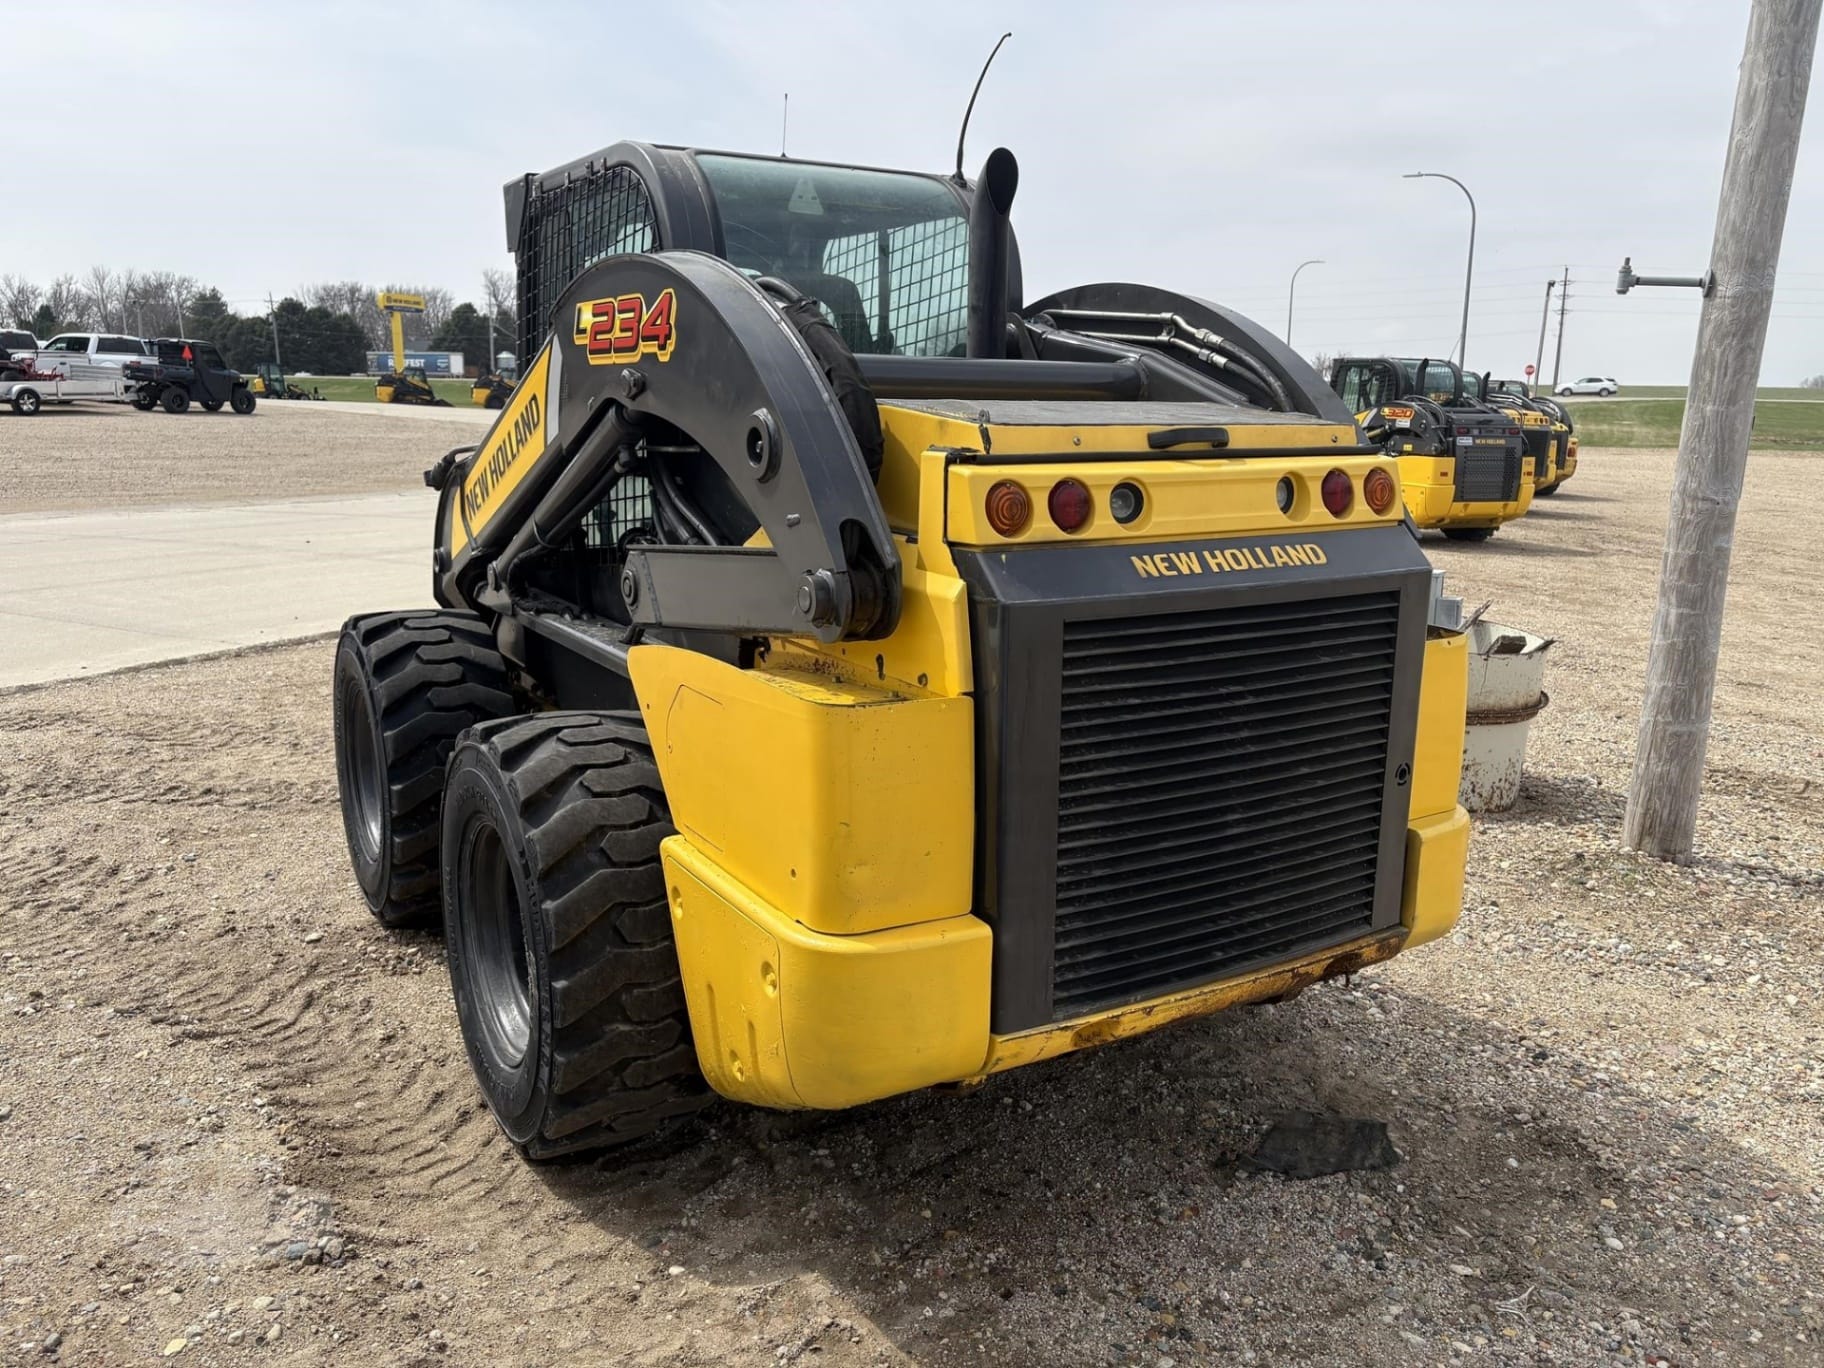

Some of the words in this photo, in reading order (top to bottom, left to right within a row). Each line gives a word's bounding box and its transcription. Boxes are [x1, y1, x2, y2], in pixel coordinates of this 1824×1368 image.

[575, 289, 676, 363] L234
[466, 467, 489, 520] NEW
[488, 393, 540, 489] HOLLAND
[1130, 551, 1203, 578] NEW
[1203, 543, 1328, 573] HOLLAND
